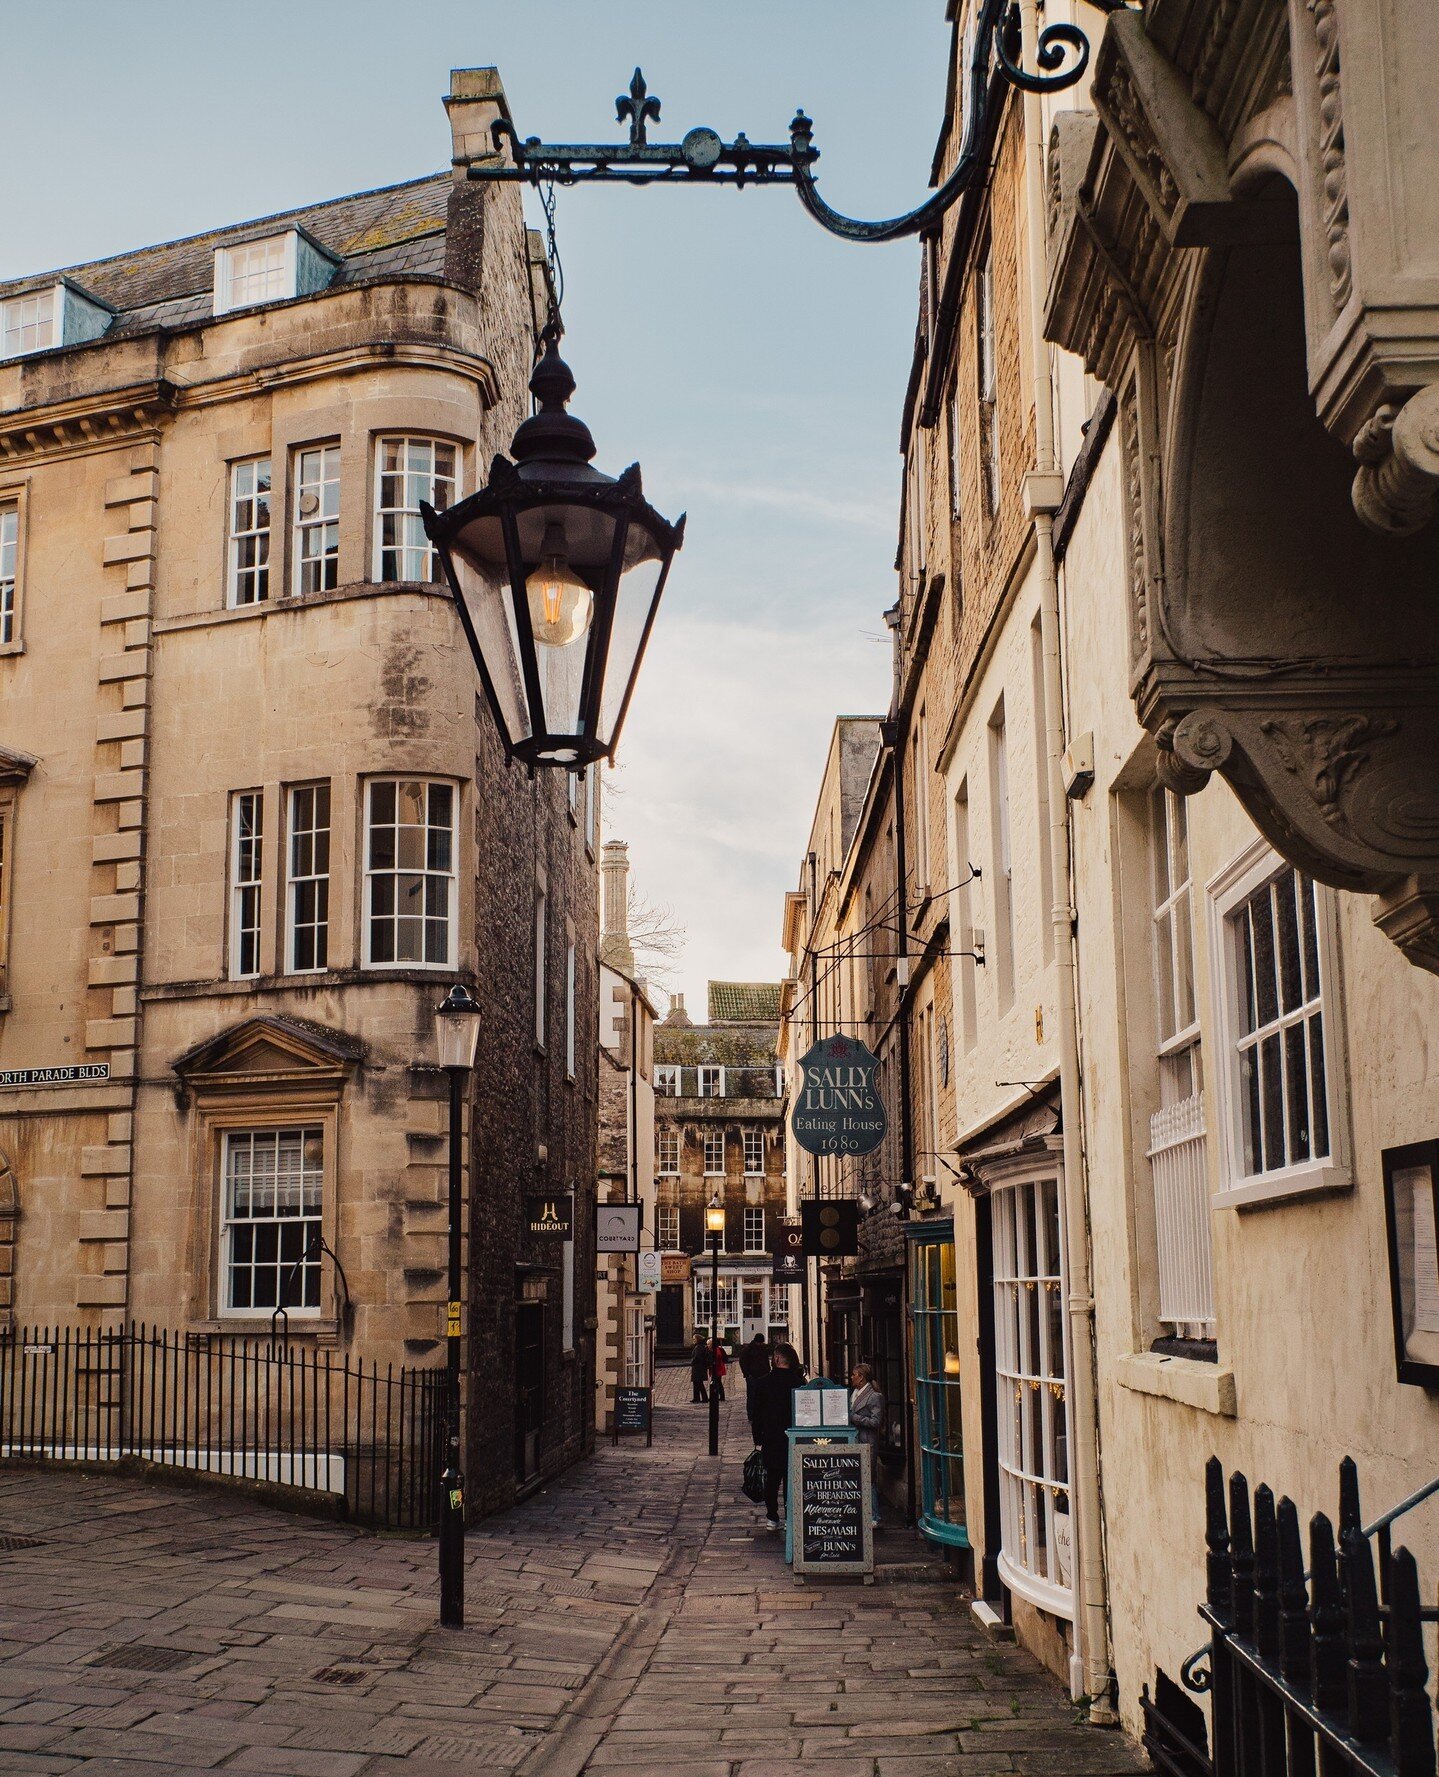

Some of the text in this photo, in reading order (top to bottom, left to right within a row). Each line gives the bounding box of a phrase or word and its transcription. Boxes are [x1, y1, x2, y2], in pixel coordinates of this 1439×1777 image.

[32, 1068, 74, 1082] PARADE
[79, 1065, 107, 1078] BLDS
[808, 1066, 872, 1088] SALLY
[796, 1117, 883, 1132] Eating House
[821, 1135, 859, 1149] 1680
[531, 1222, 569, 1231] HIDEOUT
[803, 1457, 829, 1468] SALLY
[806, 1480, 858, 1490] BATH BUNN
[817, 1491, 862, 1500] BREAKFASTS
[804, 1504, 858, 1515] Afternoon Tea
[808, 1526, 827, 1535] PIES
[831, 1526, 857, 1535] MASH
